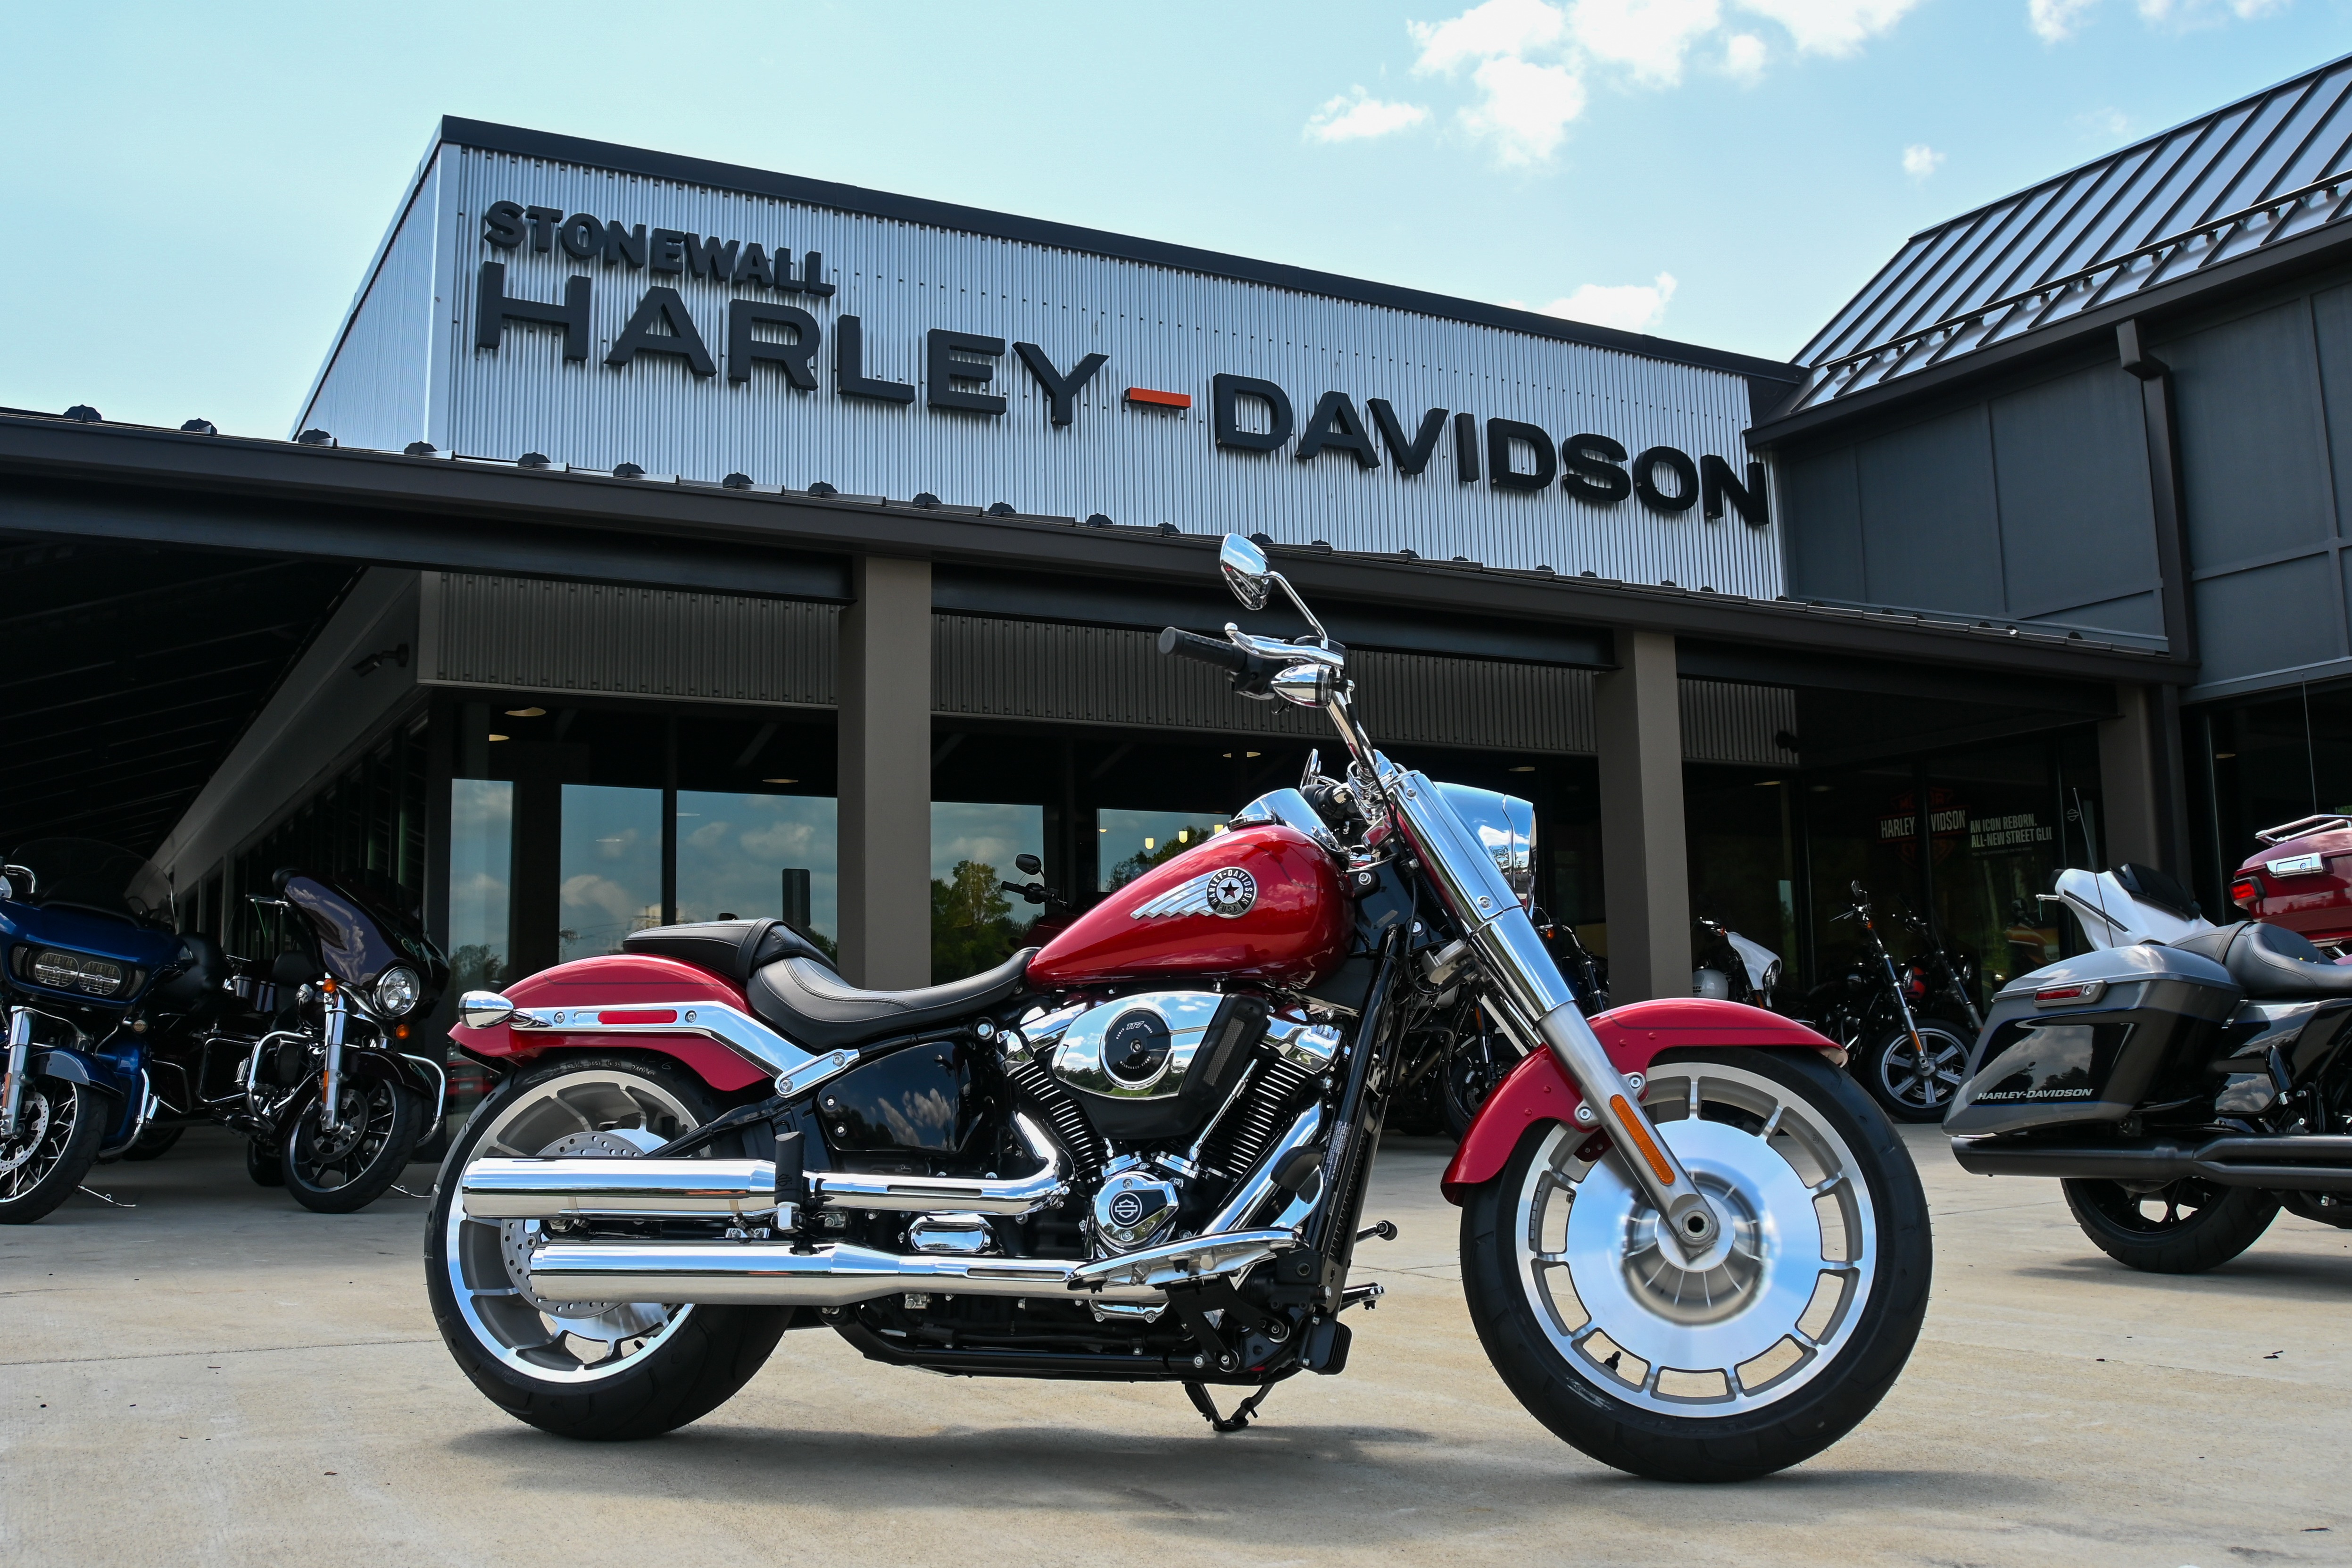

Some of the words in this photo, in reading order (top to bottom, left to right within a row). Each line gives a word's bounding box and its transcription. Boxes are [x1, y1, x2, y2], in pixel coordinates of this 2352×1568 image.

[484, 199, 835, 298] STONEWALL
[1970, 820, 1981, 833] AN
[1982, 817, 2001, 832] ICON
[2003, 813, 2037, 830] REBORN.
[1971, 831, 2004, 848] ALL-NEW
[2006, 829, 2035, 844] STREET
[1208, 869, 1253, 905] HARLEY-DAVIDSON
[1222, 905, 1238, 913] USA
[1126, 1021, 1145, 1030] 117
[1977, 1088, 2094, 1100] HARLEY-DAVIDSON
